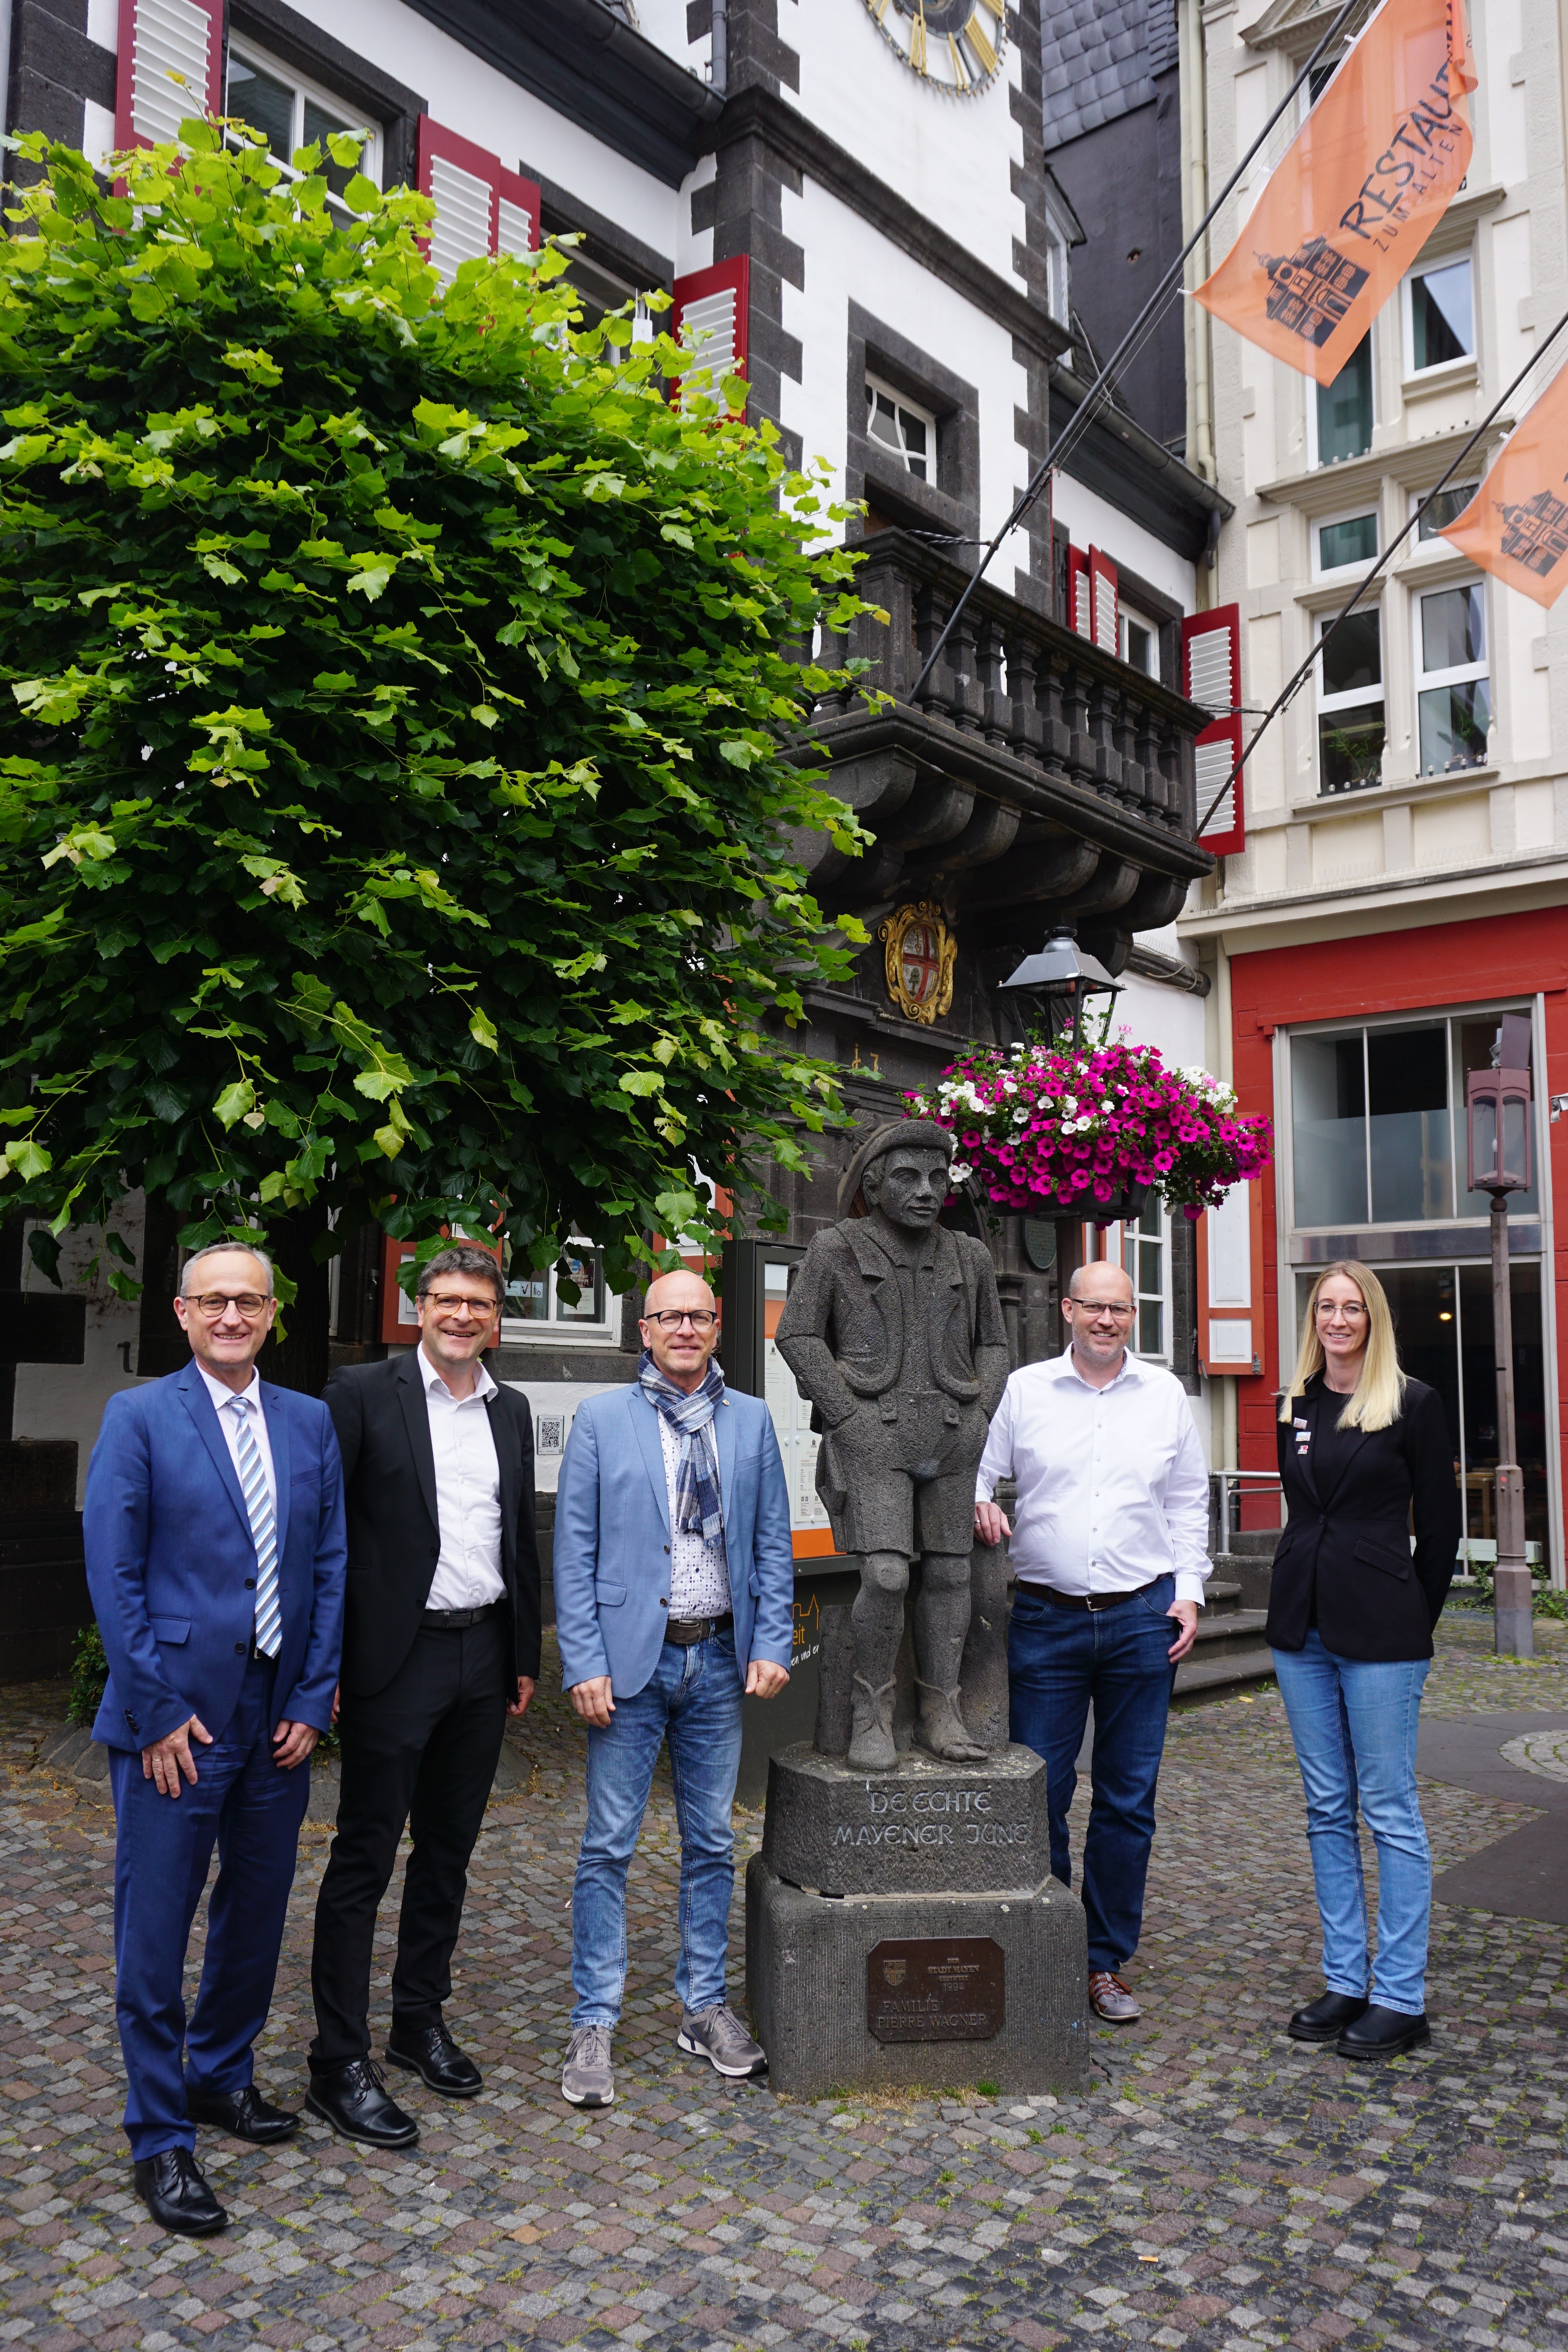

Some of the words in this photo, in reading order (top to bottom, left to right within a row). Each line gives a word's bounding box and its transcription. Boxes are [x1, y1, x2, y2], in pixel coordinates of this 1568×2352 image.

[1340, 3, 1453, 239] RESTAU
[1373, 206, 1411, 253] ZUM
[1412, 123, 1463, 195] ALTEN
[793, 1624, 805, 1645] eit
[801, 1644, 811, 1661] und
[871, 1790, 906, 1813] DE
[912, 1789, 992, 1813] ECHTE
[831, 1823, 954, 1846] MAYENER
[967, 1822, 1029, 1844] JUNG
[927, 1966, 952, 1975] STADT
[953, 1965, 980, 1974] MAYEN
[944, 1983, 964, 1991] 1994
[883, 2000, 939, 2013] FAMILIE
[877, 2016, 925, 2029] PIERRE
[929, 2014, 987, 2027] WAGNER
